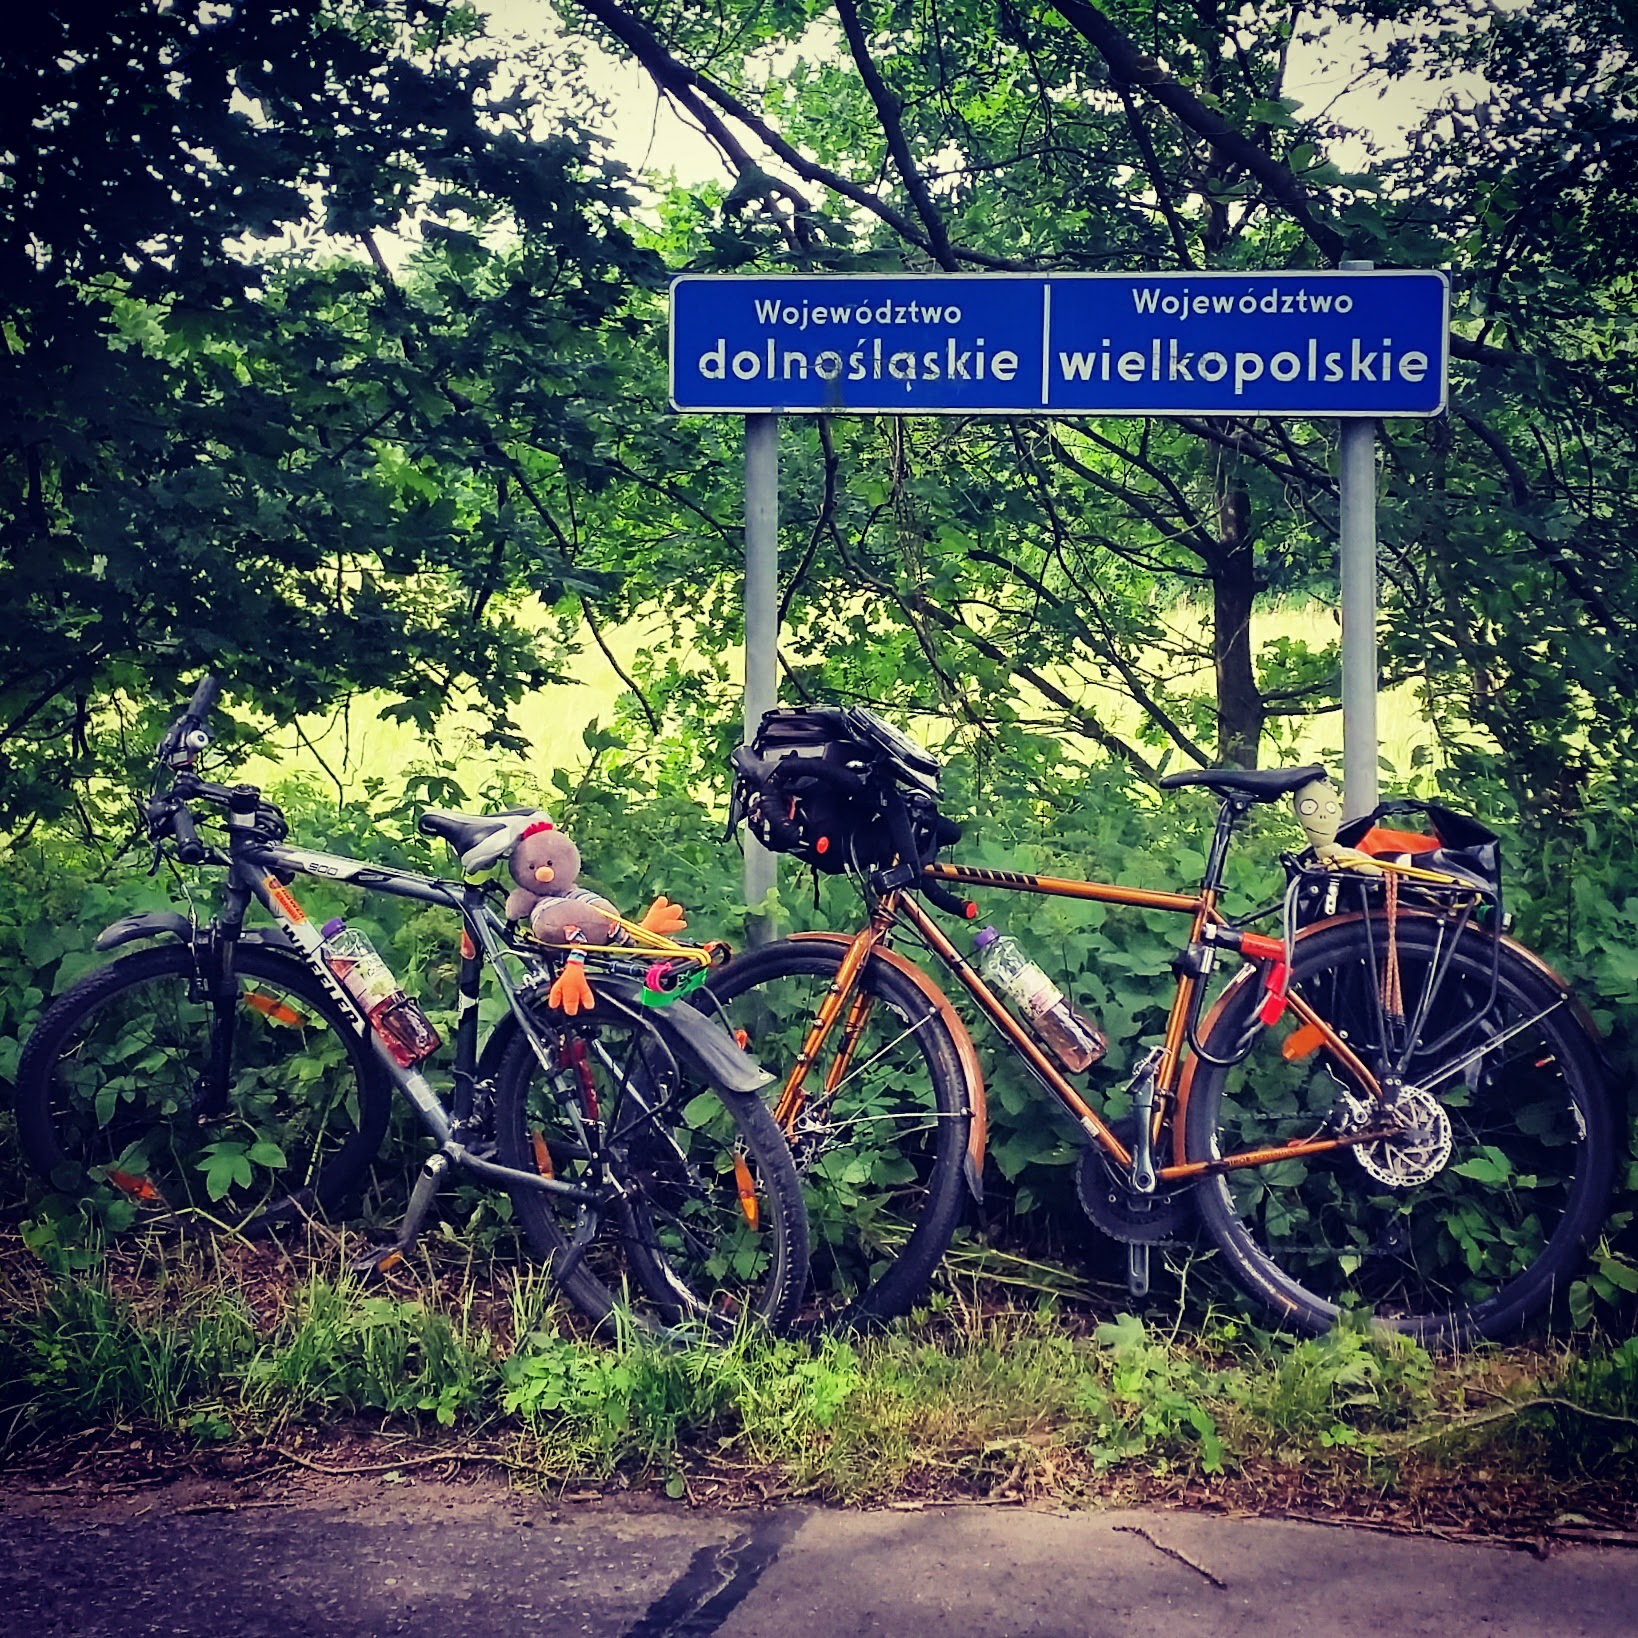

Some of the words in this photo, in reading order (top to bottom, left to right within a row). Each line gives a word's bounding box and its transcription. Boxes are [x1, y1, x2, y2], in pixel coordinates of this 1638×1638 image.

[754, 298, 962, 331] Województwo
[1132, 287, 1353, 321] Województwo
[698, 338, 1019, 392] dolnośląskie
[1058, 338, 1429, 395] wielkopolskie
